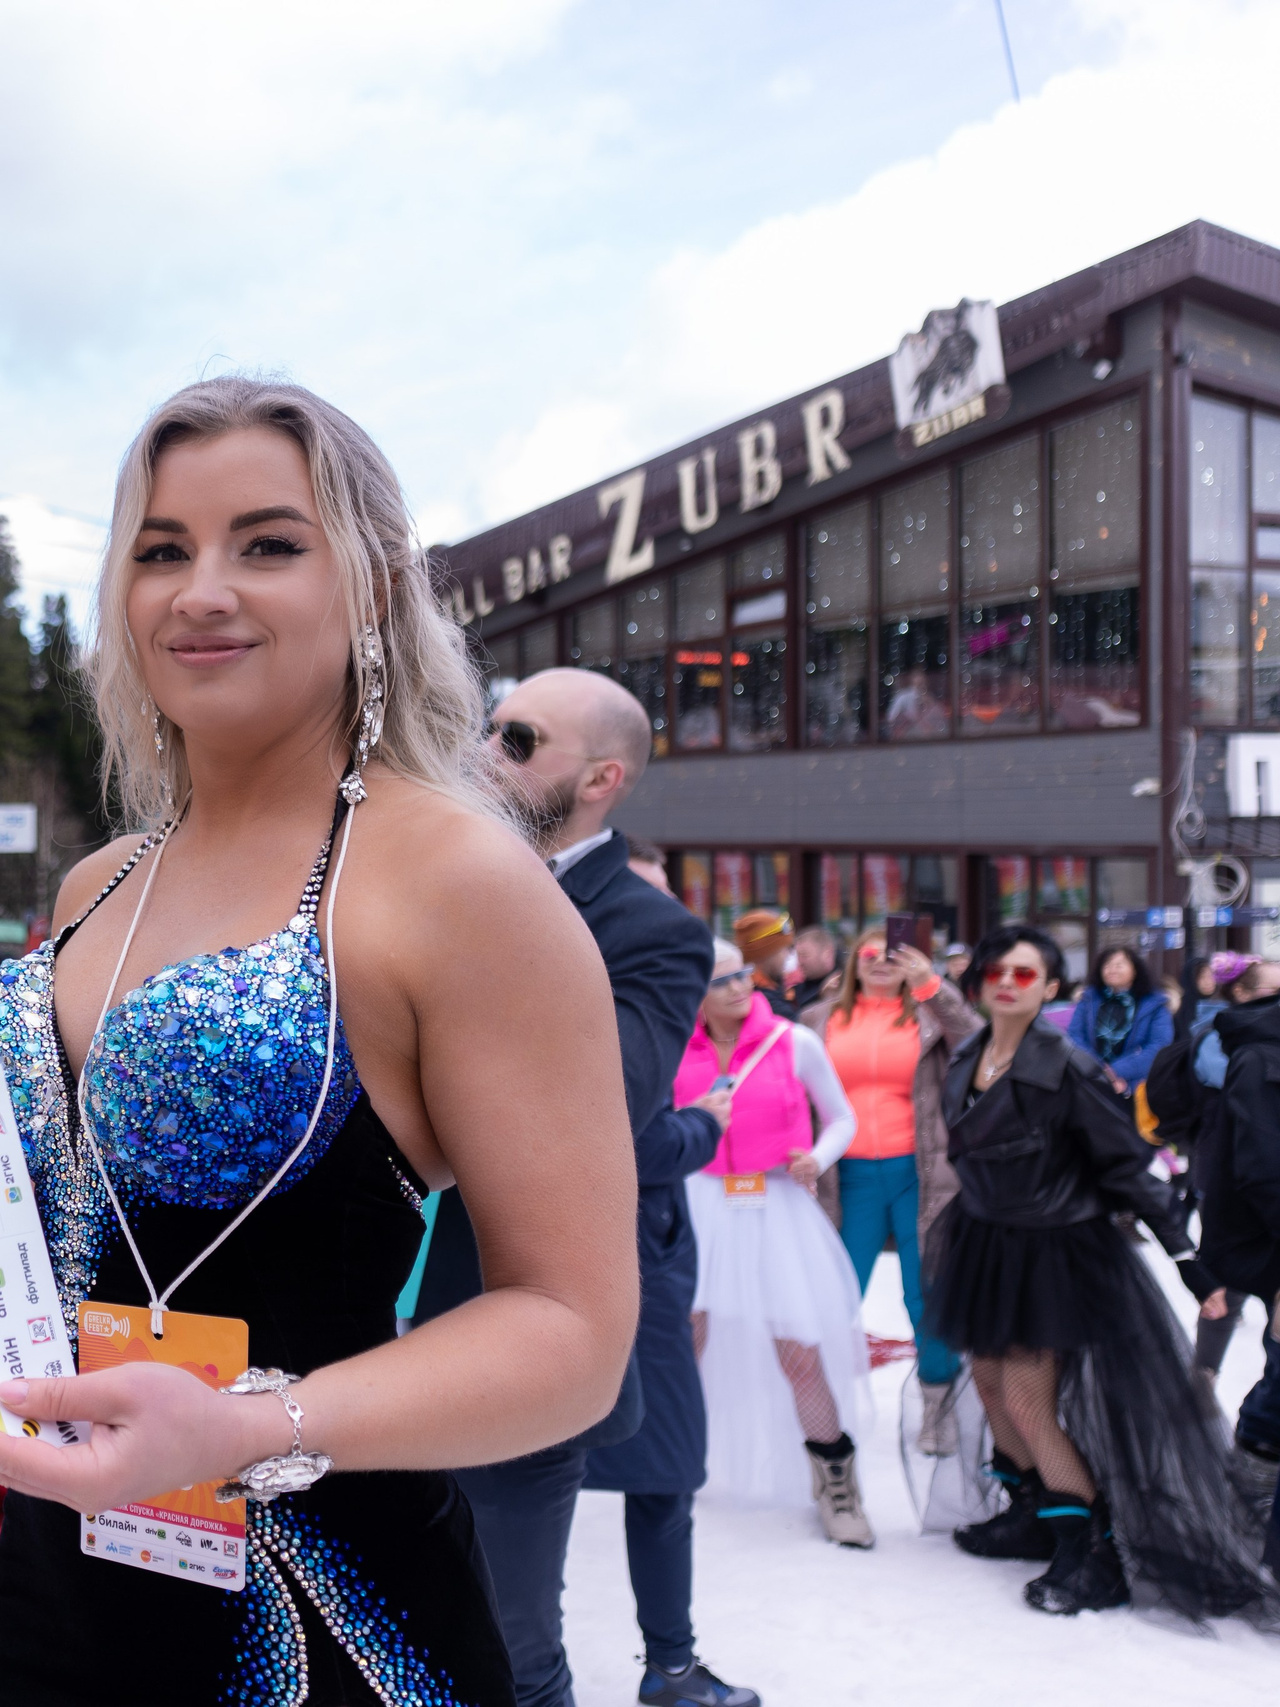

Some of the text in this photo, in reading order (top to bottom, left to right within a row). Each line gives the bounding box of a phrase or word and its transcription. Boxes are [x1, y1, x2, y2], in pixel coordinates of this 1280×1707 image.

[912, 397, 988, 448] ZUBR
[596, 388, 852, 586] ZUBR
[502, 534, 572, 604] BAR
[0, 1154, 15, 1185] 2ГИС
[88, 1323, 104, 1332] FEST
[98, 1515, 138, 1533] билайн
[129, 1504, 154, 1518] СПУСКА
[155, 1510, 189, 1525] «КРАСНАЯ
[190, 1517, 228, 1533] ДОРОЖКА»
[189, 1563, 206, 1573] 2ГИС
